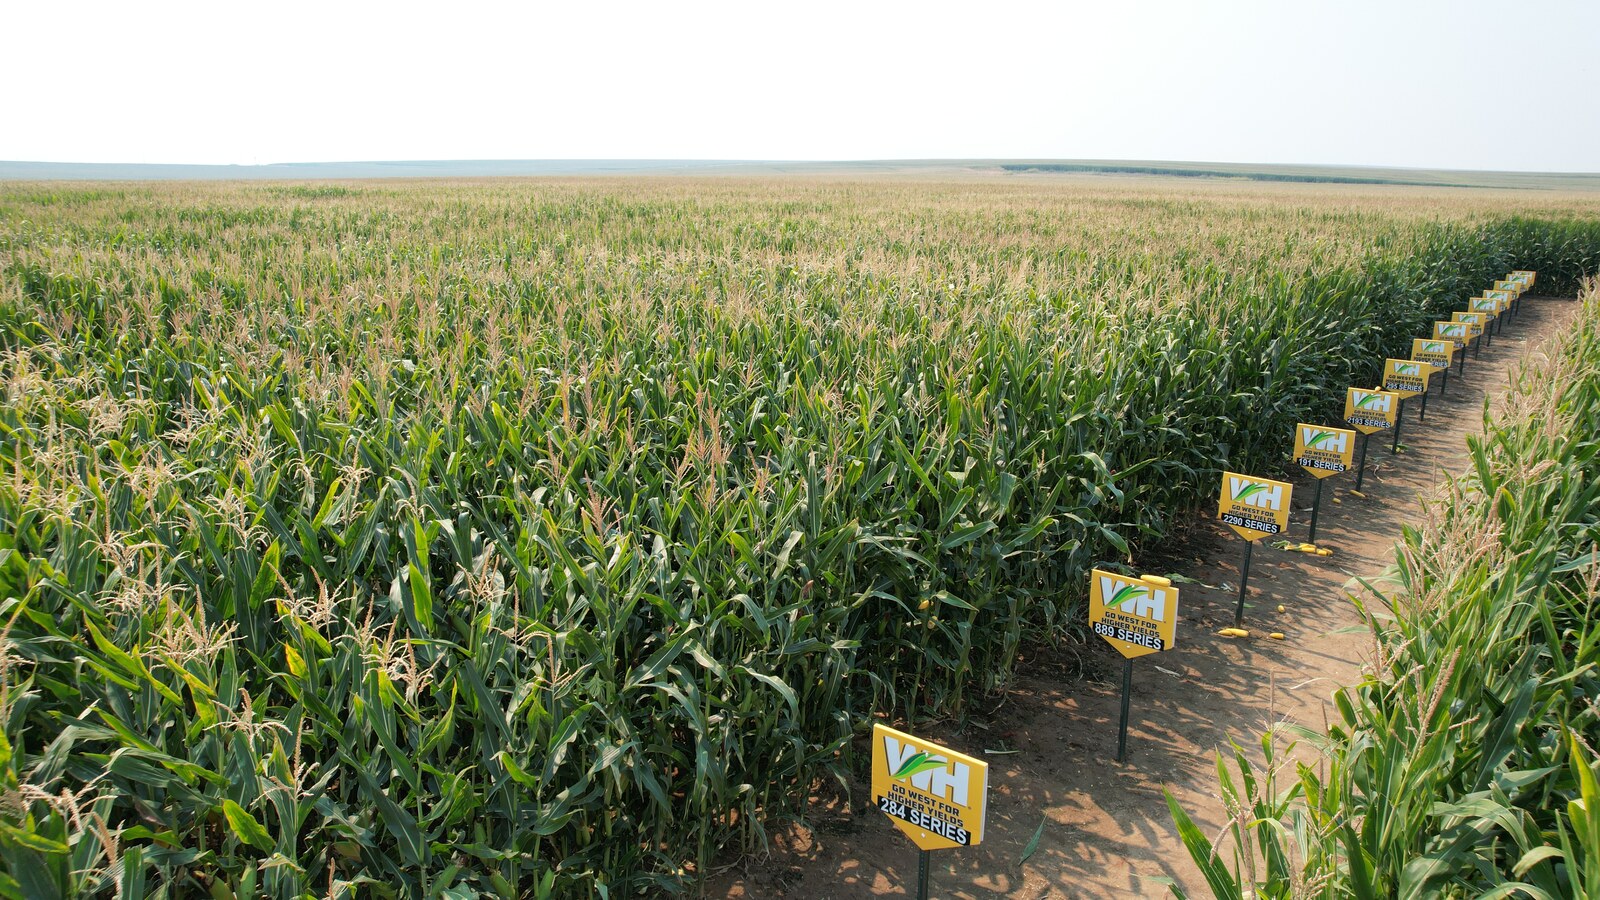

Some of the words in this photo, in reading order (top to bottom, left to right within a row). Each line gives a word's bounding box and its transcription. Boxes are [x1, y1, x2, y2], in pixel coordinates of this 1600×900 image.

[1364, 419, 1390, 428] SERIES
[1314, 461, 1344, 472] SERIES
[1224, 515, 1243, 526] 2290
[1245, 520, 1278, 534] SERIES
[1229, 510, 1252, 518] HIGHER
[1254, 515, 1276, 523] YIELDS
[1102, 618, 1130, 630] HIGHER
[1132, 626, 1159, 637] YIELDS
[1118, 615, 1140, 625] WEST
[1141, 621, 1157, 630] FOR
[1095, 623, 1114, 636] 889
[1117, 629, 1161, 650] SERIES
[888, 791, 924, 811] HIGHER
[928, 807, 963, 827] YIELDS
[892, 784, 905, 795] GO
[908, 790, 936, 807] WEST
[940, 802, 959, 816] FOR
[880, 798, 906, 819] 284
[910, 809, 967, 845] SERIES
